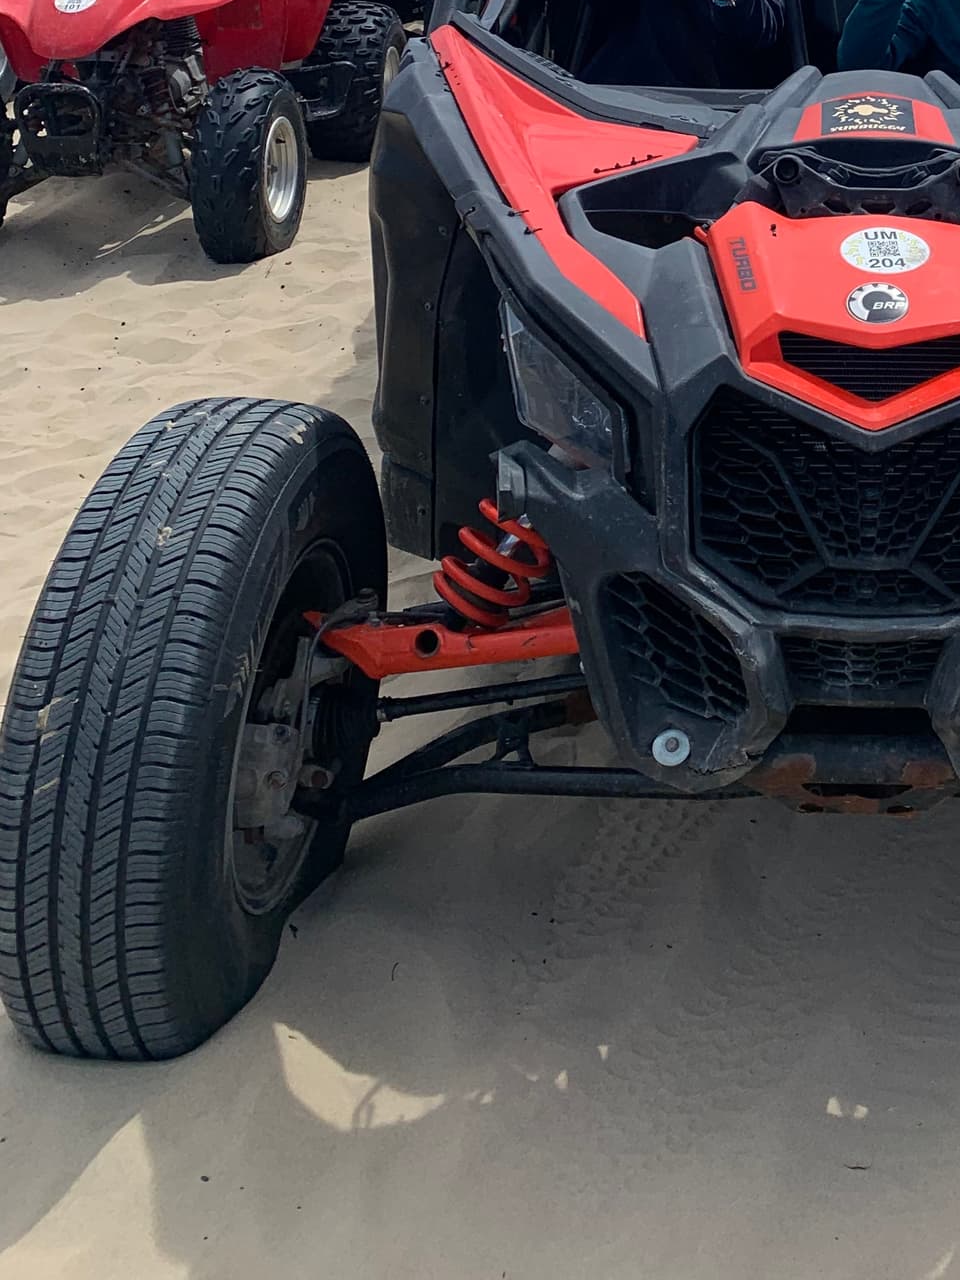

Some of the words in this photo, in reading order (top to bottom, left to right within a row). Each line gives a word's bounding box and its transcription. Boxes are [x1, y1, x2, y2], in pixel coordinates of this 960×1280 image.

[864, 231, 898, 240] UM
[729, 236, 757, 291] TURBO
[869, 258, 906, 269] 204
[872, 301, 906, 310] BRP
